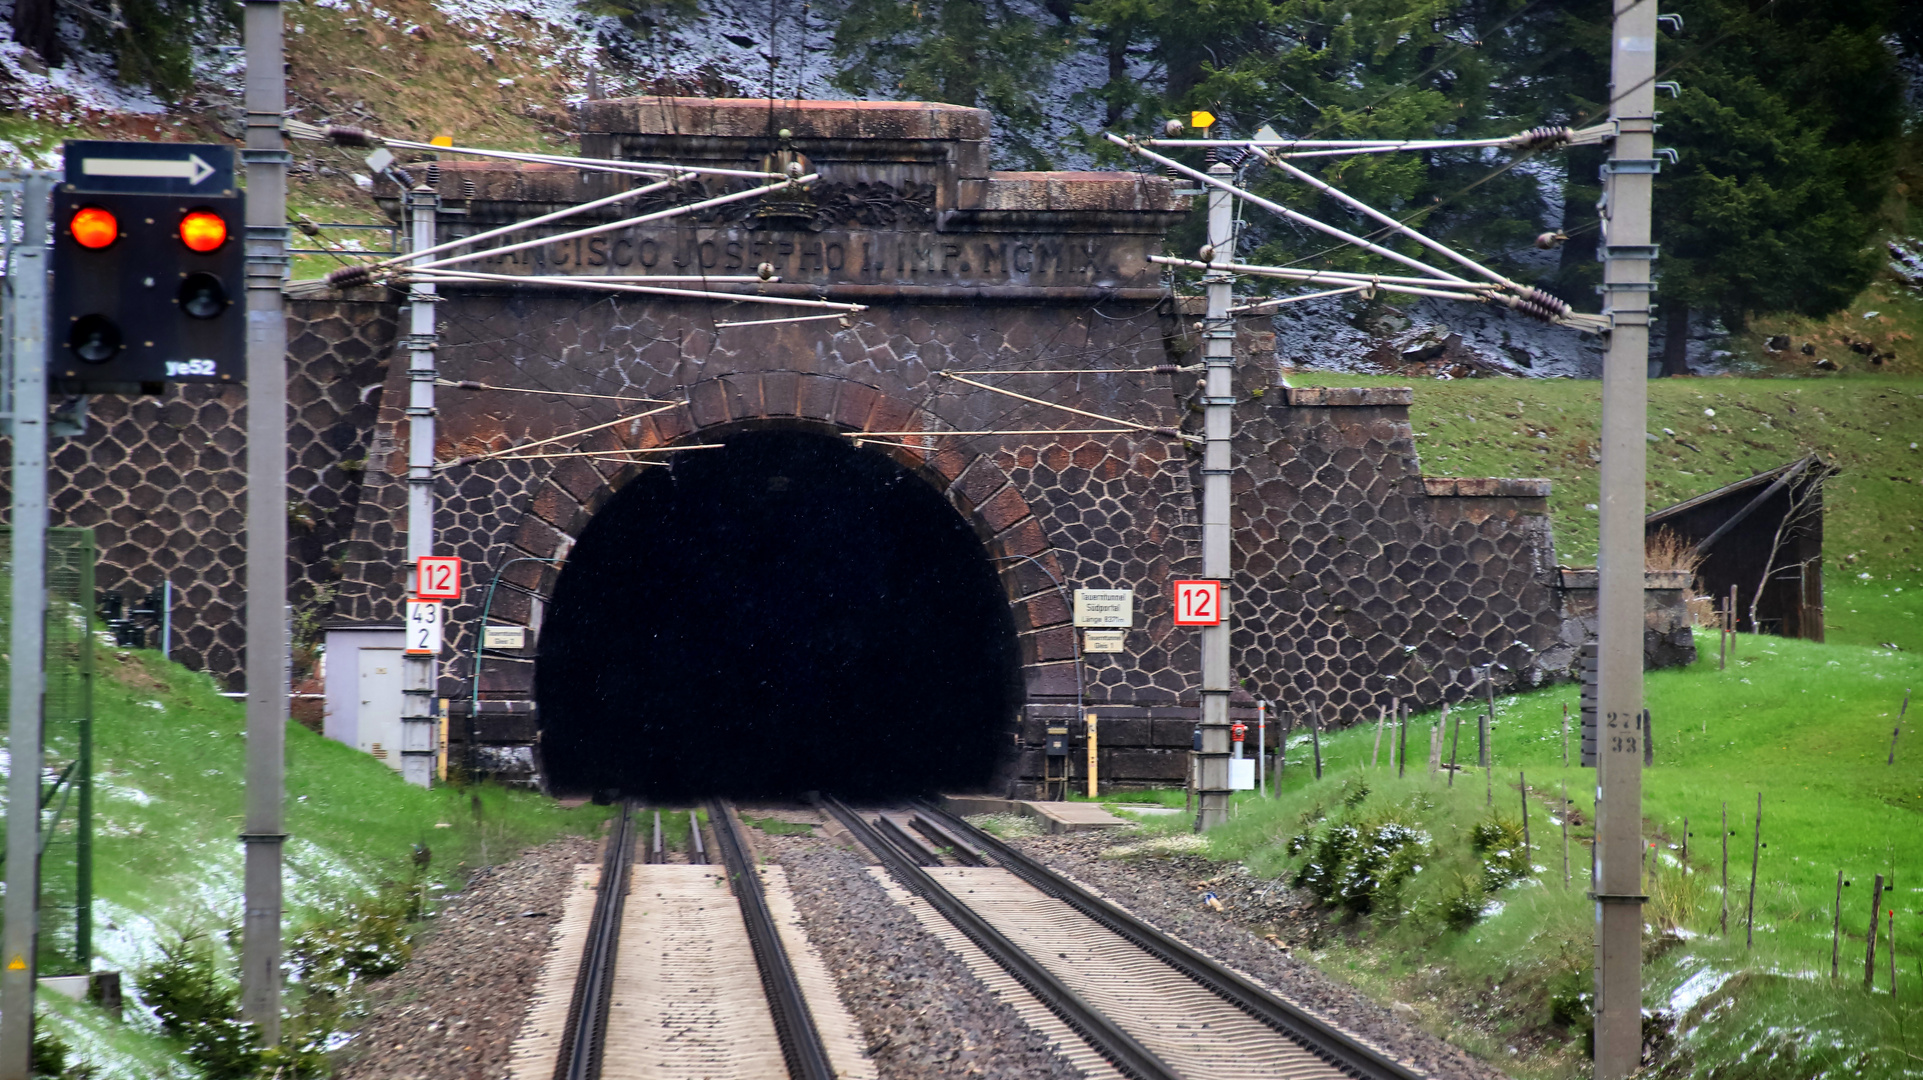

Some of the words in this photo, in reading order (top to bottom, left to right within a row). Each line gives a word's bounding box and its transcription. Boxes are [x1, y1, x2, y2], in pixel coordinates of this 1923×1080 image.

[673, 237, 845, 271] JOSEPHO
[165, 359, 216, 377] ye52
[425, 564, 451, 590] 12
[1081, 592, 1126, 601] Tauerntunnel
[1183, 588, 1211, 617] 12
[412, 603, 436, 624] 43
[418, 628, 429, 649] 2
[1612, 736, 1637, 753] 33
